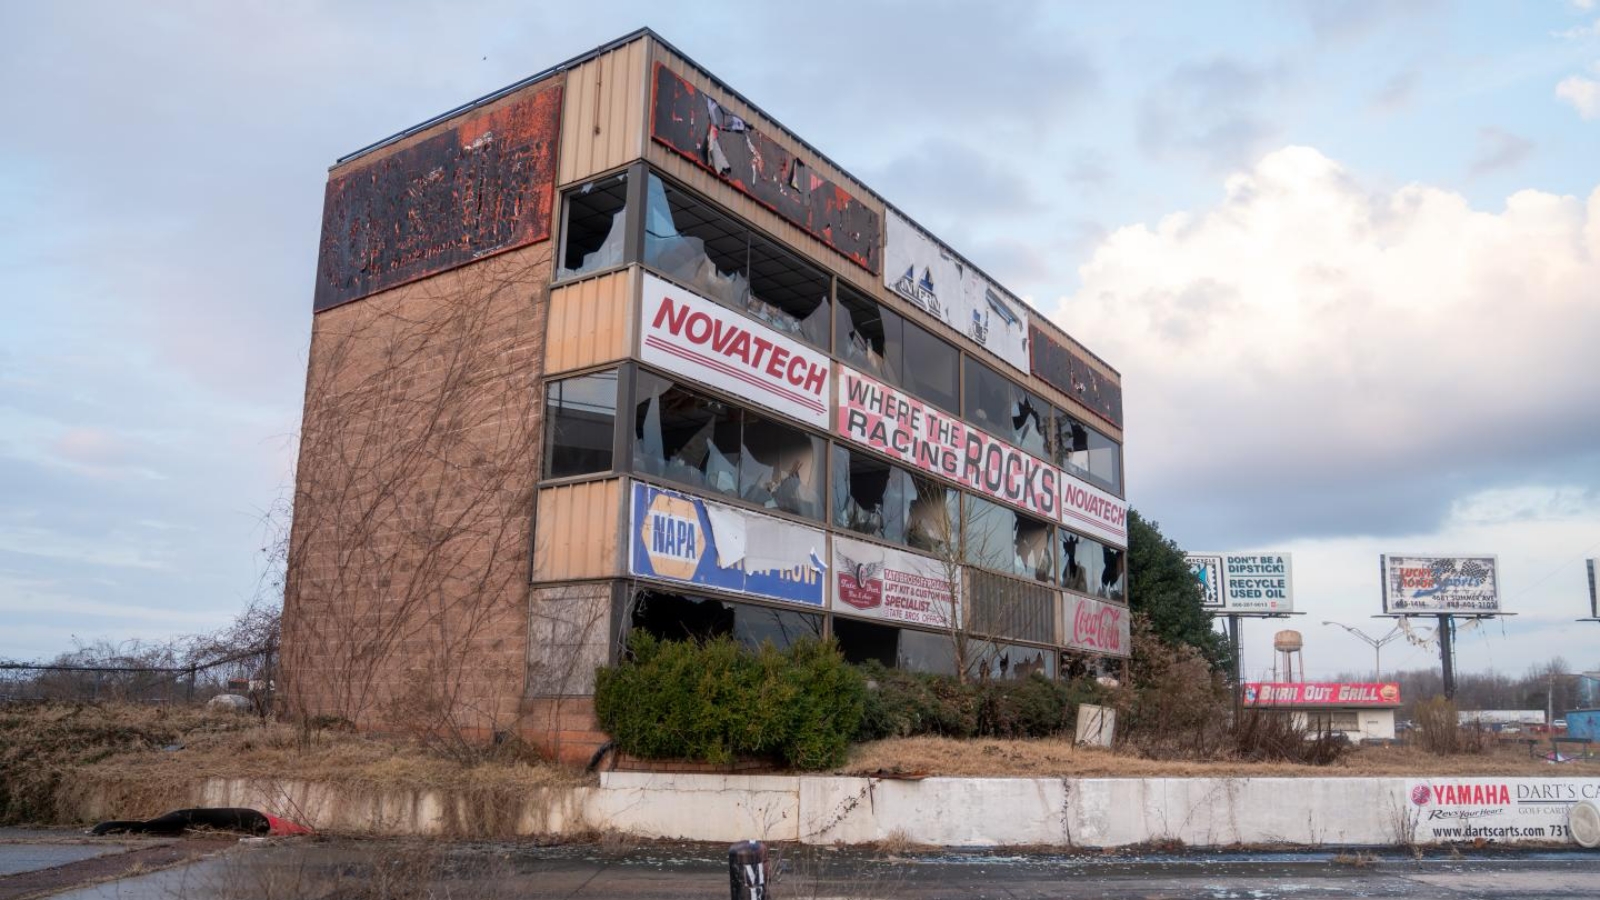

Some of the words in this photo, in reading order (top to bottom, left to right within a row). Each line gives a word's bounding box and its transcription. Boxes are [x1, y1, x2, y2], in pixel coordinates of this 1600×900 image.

[652, 297, 827, 395] NOVATECH
[848, 375, 920, 429] WHERE
[928, 414, 959, 448] THE
[847, 408, 957, 473] RACING
[963, 431, 1055, 513] ROCKS
[1065, 483, 1126, 527] NOVATECH
[653, 515, 696, 559] NAPA
[1227, 556, 1256, 564] DON'T
[1229, 565, 1284, 573] DIPSTICK!
[1400, 568, 1431, 578] LUCKY
[885, 582, 898, 592] LIFT
[899, 584, 910, 595] KIT
[1230, 580, 1285, 589] RECYCLE
[1230, 589, 1262, 598] USED
[1266, 589, 1286, 598] OIL
[885, 594, 930, 612] SPECIALIST
[1304, 685, 1333, 700] OUT
[1338, 685, 1379, 700] GRILL
[1433, 784, 1510, 805] YAMAHA
[1517, 784, 1576, 799] DART'S
[1428, 808, 1457, 821] Revs
[1459, 810, 1480, 819] Your
[1480, 808, 1503, 817] Heart
[1433, 825, 1545, 837] www.dartscarts.com
